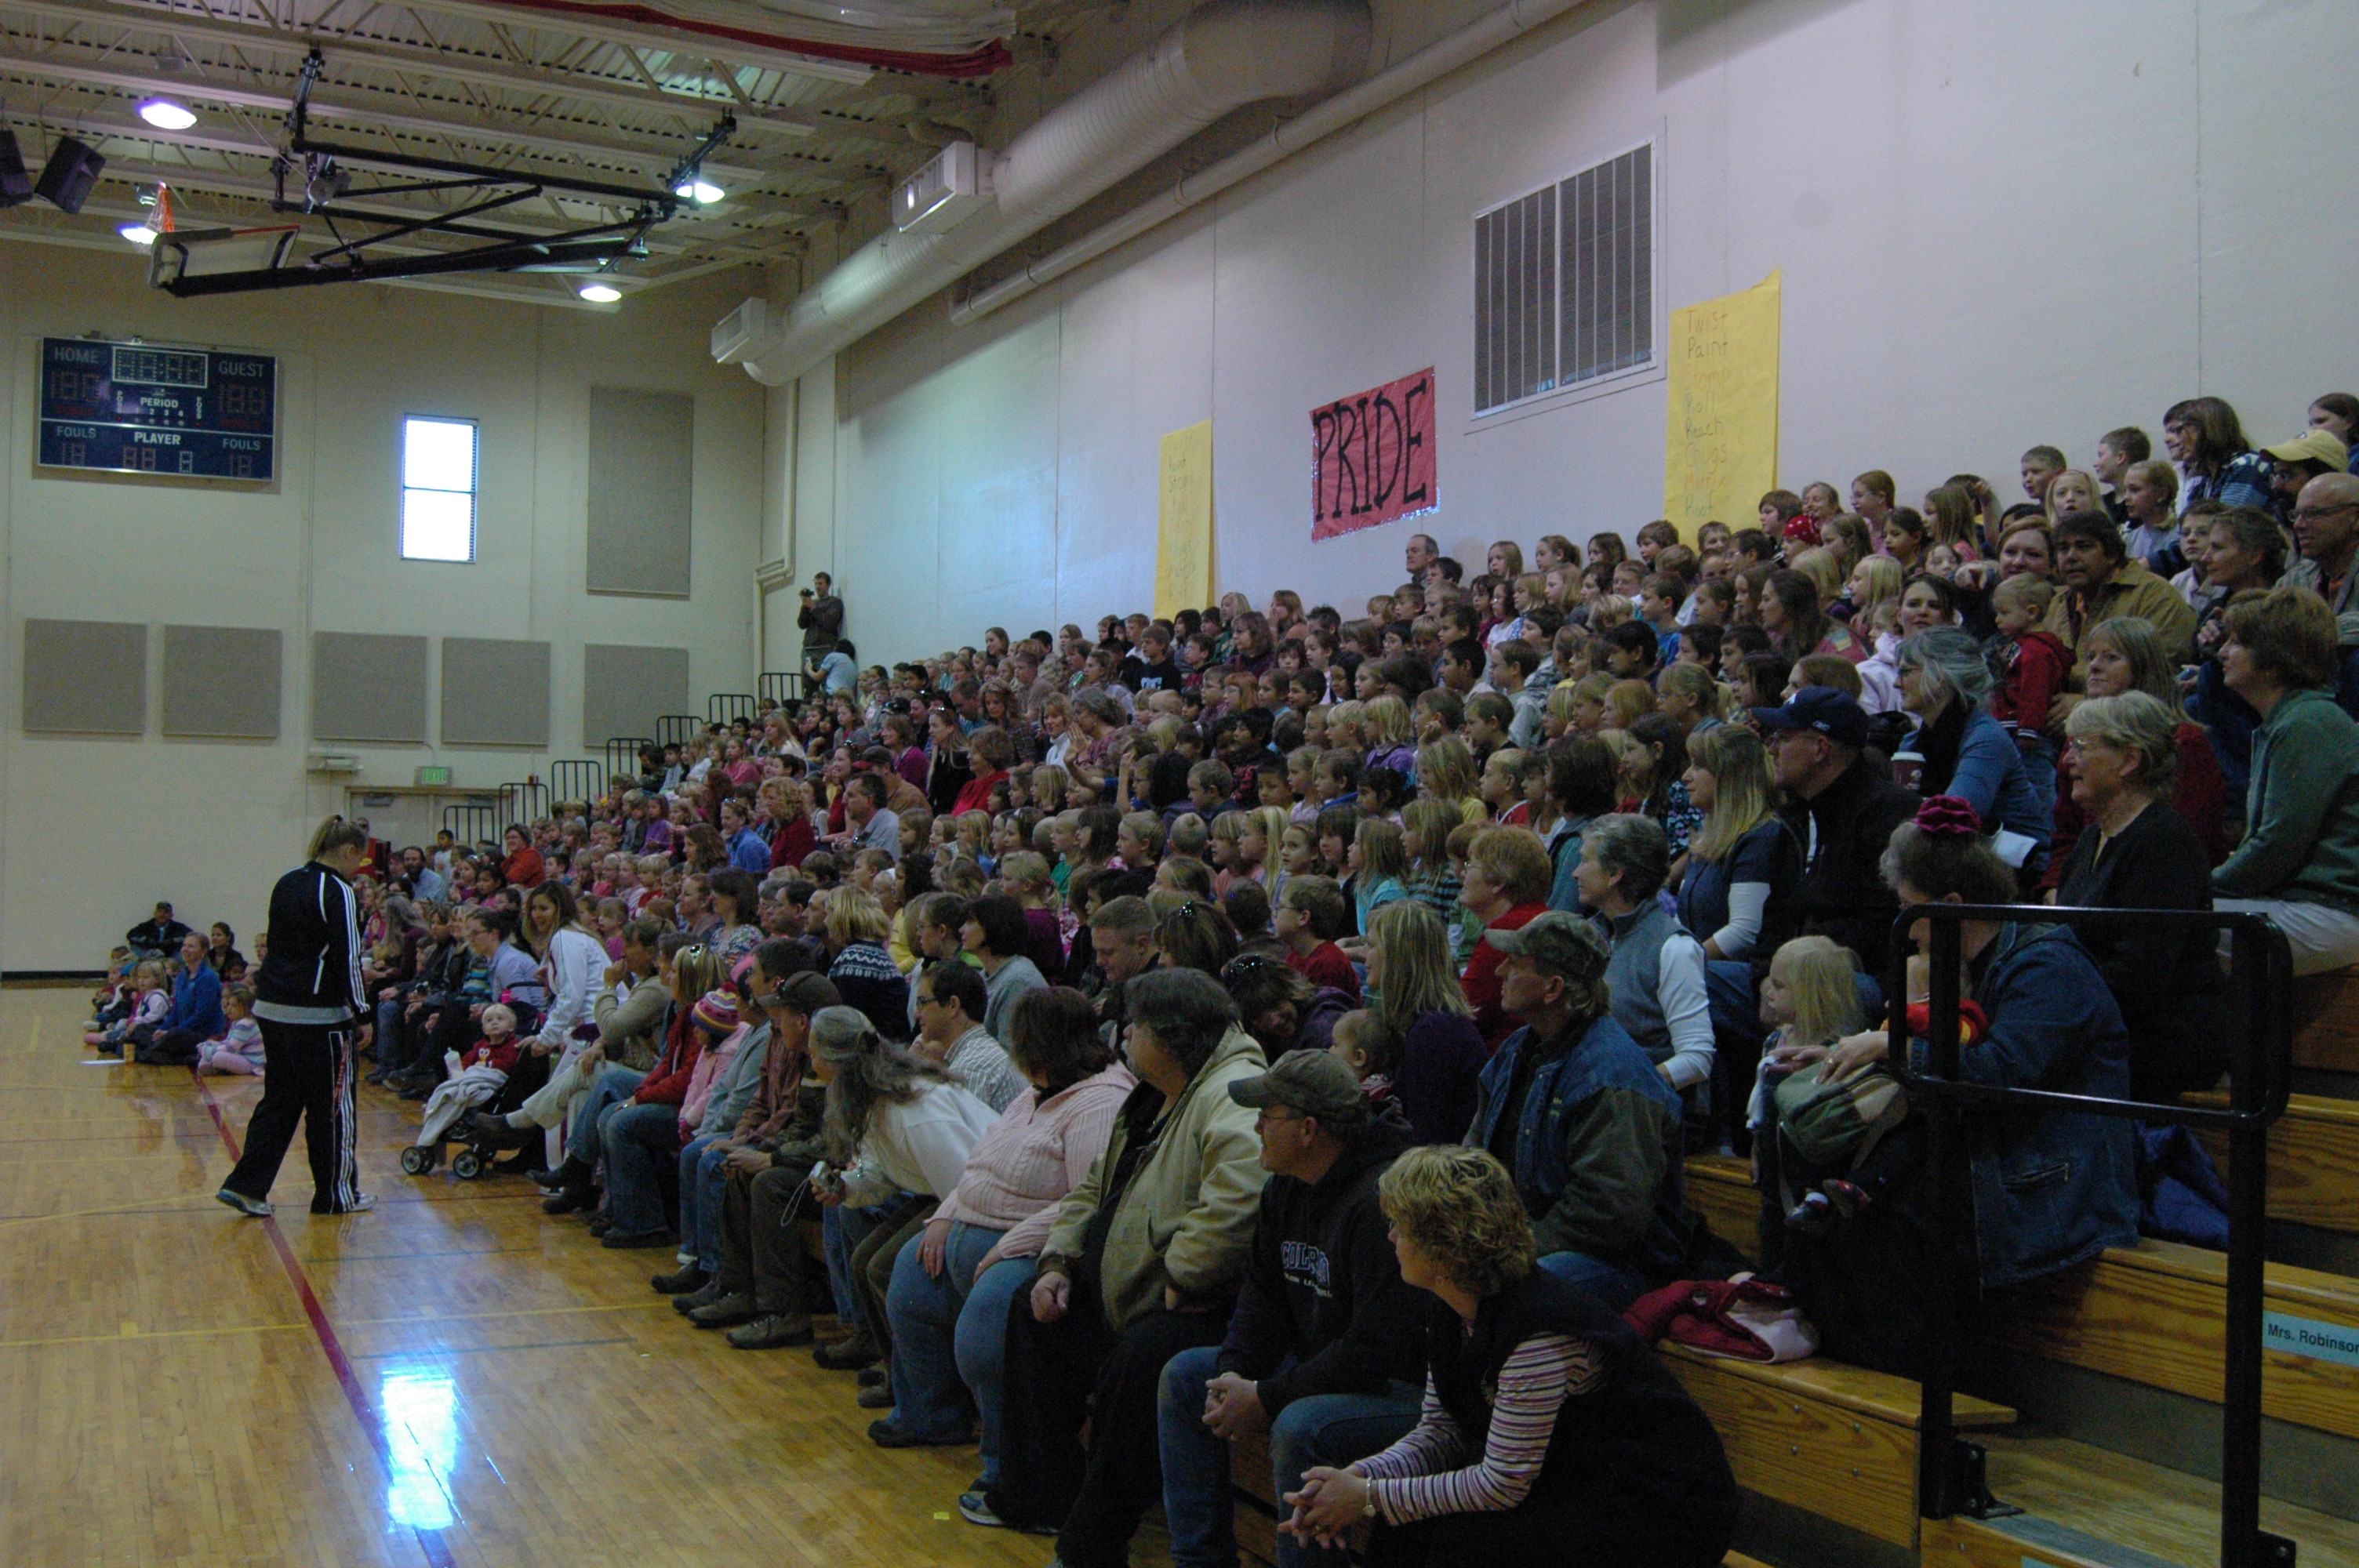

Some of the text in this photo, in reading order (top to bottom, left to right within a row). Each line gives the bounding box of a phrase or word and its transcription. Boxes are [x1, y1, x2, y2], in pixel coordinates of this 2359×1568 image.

[1686, 303, 1728, 332] Twist
[1688, 334, 1728, 359] Paint
[54, 347, 99, 364] HOME
[219, 361, 266, 377] GUEST
[140, 397, 179, 408] PERIOD
[56, 426, 96, 439] FOULS
[135, 431, 181, 445] PLAYER
[223, 438, 261, 451] FOULS
[1313, 378, 1427, 521] PRIDE
[426, 768, 446, 782] EXIT
[2268, 1323, 2294, 1340] Mrs.
